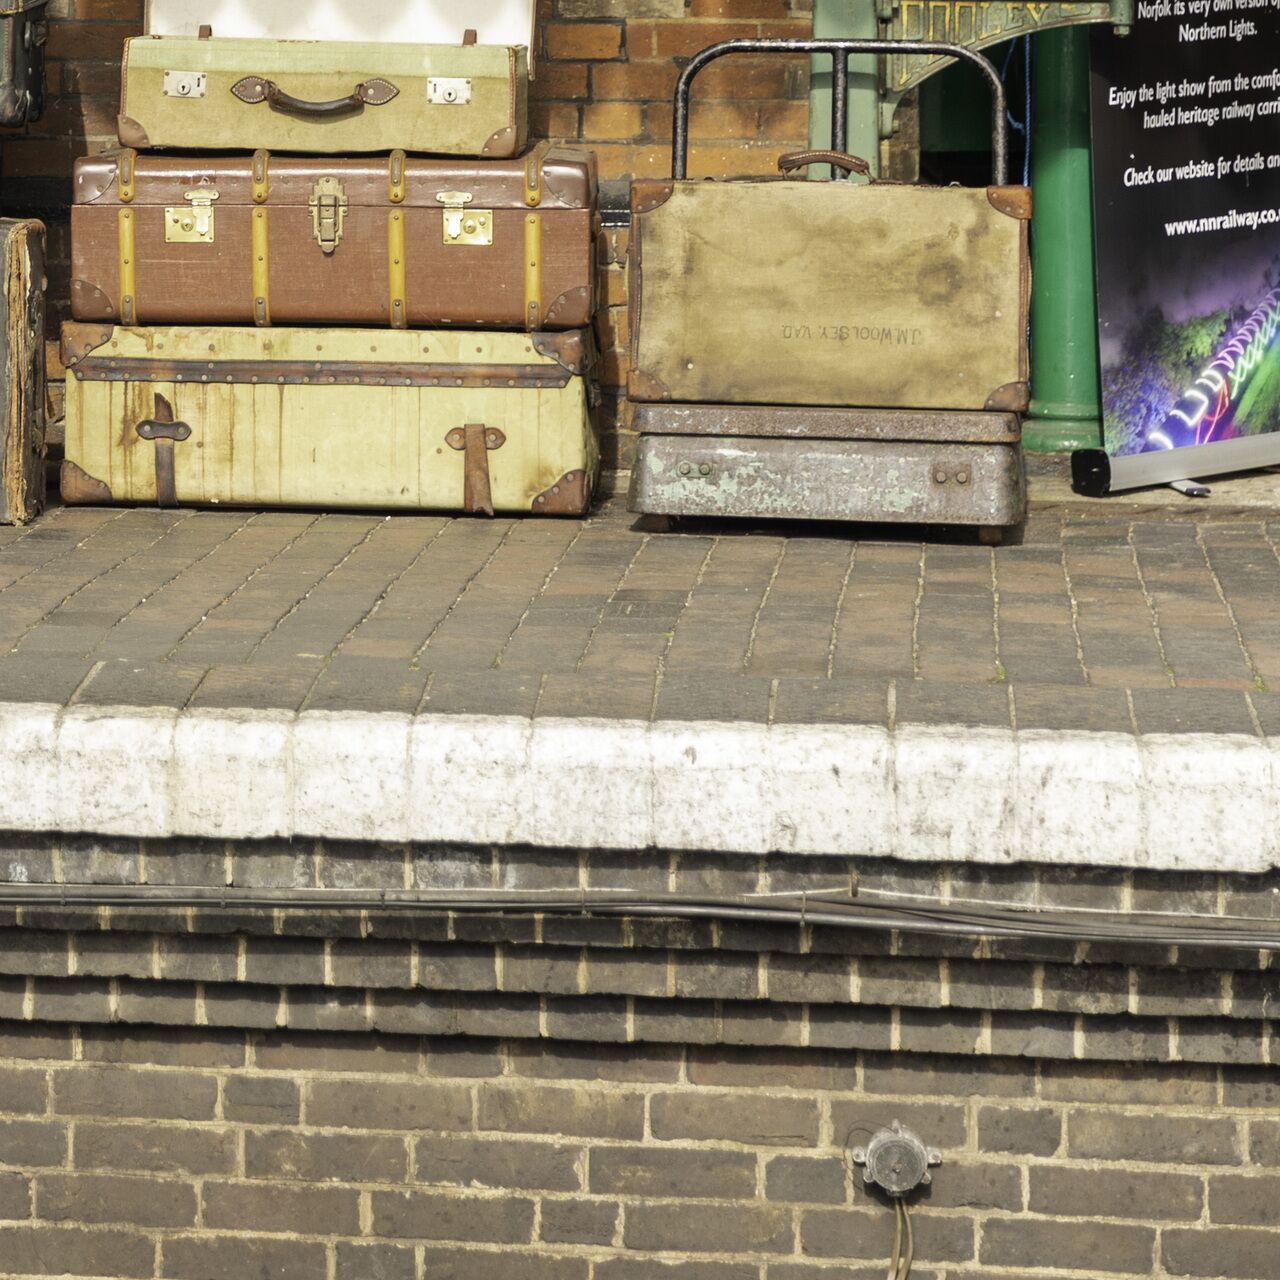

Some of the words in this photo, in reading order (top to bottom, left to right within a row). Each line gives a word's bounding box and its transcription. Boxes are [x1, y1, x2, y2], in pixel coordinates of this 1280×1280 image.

[1138, 0, 1171, 21] Norfolk
[1188, 0, 1211, 17] very
[1178, 22, 1226, 42] Northern
[1229, 18, 1257, 41] Lights.
[1108, 86, 1137, 109] Enjoy
[1139, 83, 1154, 102] the
[1156, 81, 1176, 104] light
[1178, 79, 1205, 97] show
[1208, 75, 1232, 98] from
[1234, 73, 1249, 91] the
[1144, 108, 1175, 129] hauled
[1178, 106, 1219, 126] heritage
[1222, 100, 1256, 122] railway
[1124, 166, 1154, 187] Check
[1156, 168, 1173, 183] our
[1175, 160, 1214, 179] website
[1217, 156, 1232, 179] for
[1233, 152, 1264, 173] details
[1165, 207, 1280, 236] www.nnrailway.co.
